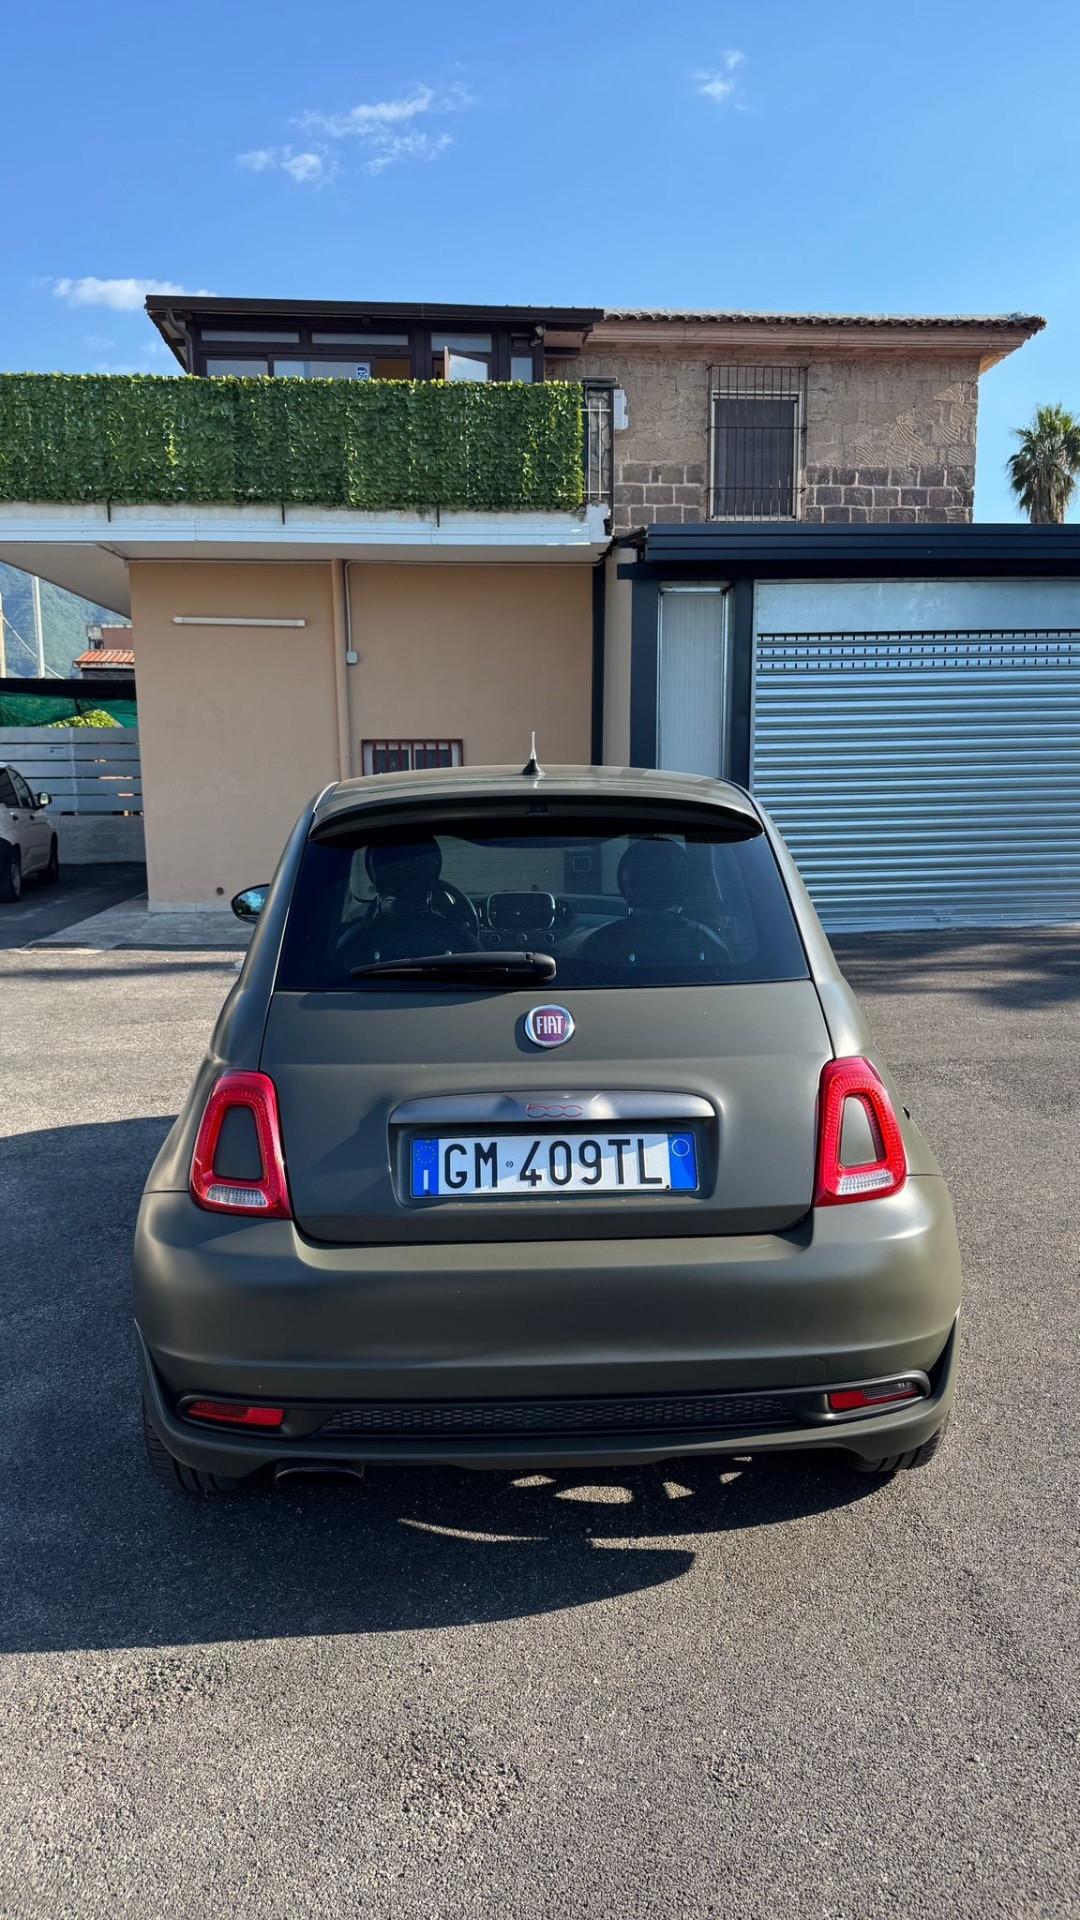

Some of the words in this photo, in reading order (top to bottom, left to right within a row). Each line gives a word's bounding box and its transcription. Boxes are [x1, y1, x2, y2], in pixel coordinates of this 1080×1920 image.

[536, 1015, 564, 1035] FIAT
[526, 1103, 583, 1119] 500
[444, 1142, 499, 1189] GM
[519, 1138, 663, 1187] 409TL
